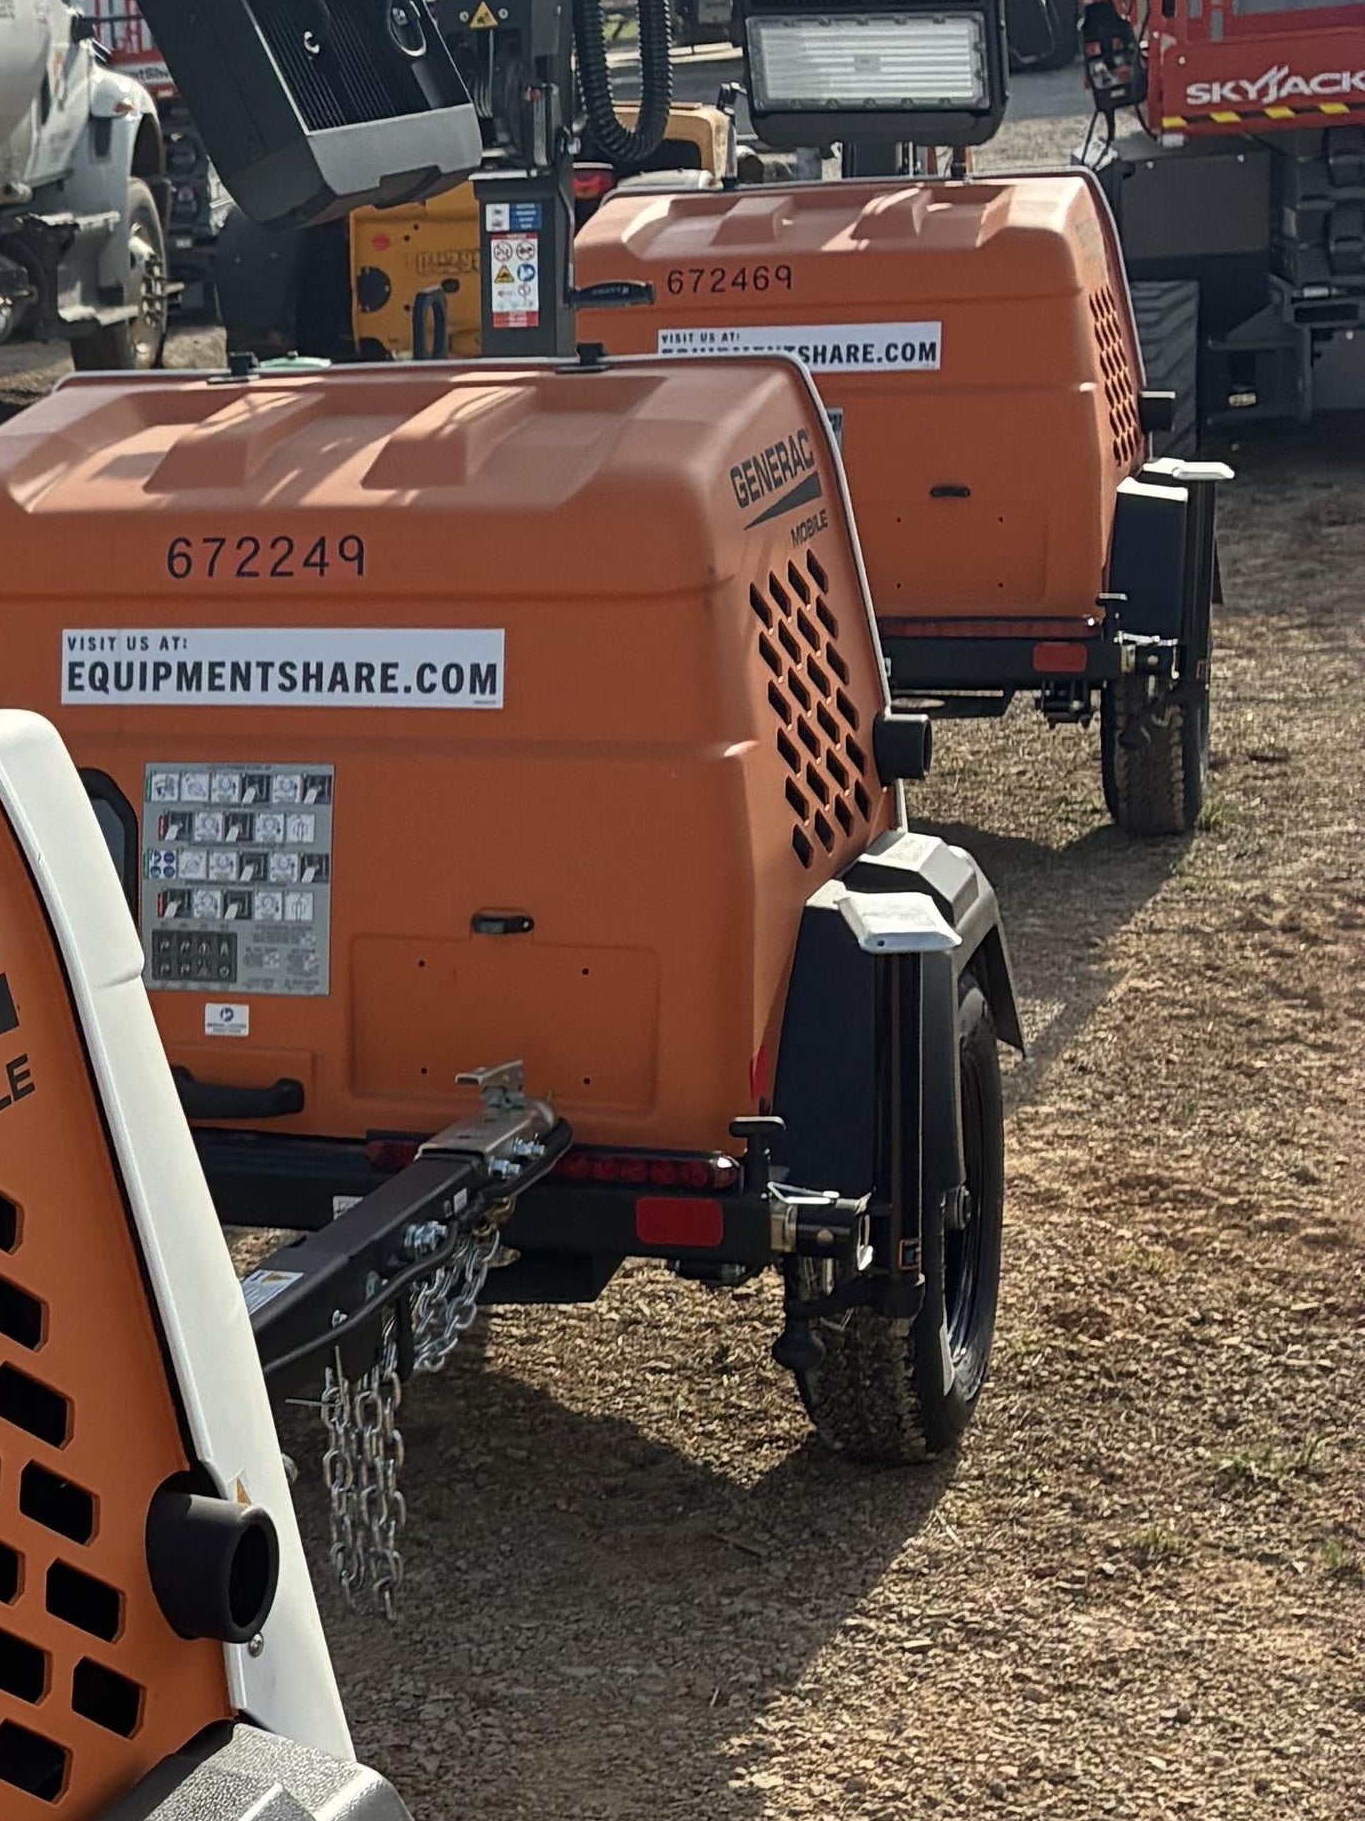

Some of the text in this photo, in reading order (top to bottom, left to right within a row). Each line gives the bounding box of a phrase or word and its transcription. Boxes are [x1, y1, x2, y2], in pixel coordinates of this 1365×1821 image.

[1186, 65, 1365, 105] SKYJACK
[667, 264, 792, 295] 672469
[661, 332, 694, 344] VISIT
[700, 331, 716, 343] US
[730, 428, 815, 509] GENERAC
[790, 509, 829, 547] MOBILE
[166, 534, 366, 580] 672249
[67, 635, 188, 652] VISIT US AT:
[67, 660, 497, 696] EQUIPMENTSHARE.COM
